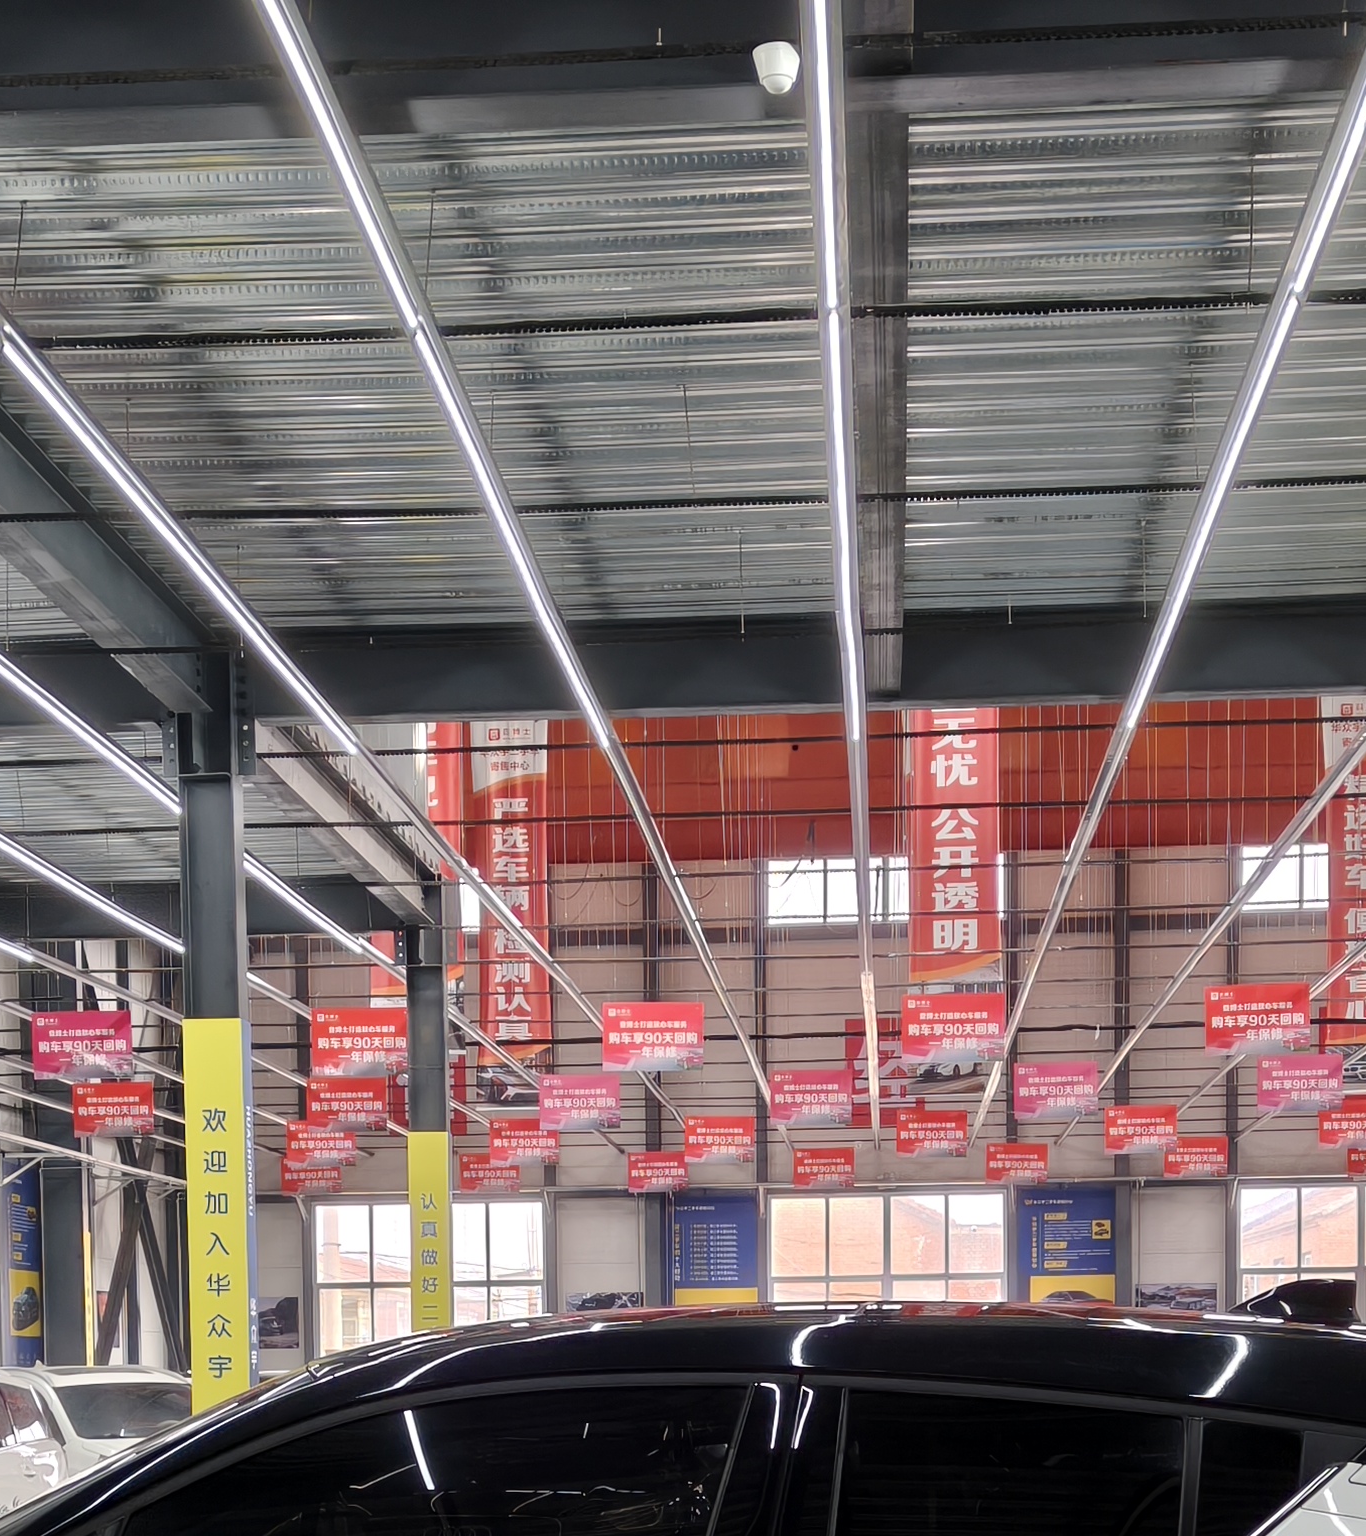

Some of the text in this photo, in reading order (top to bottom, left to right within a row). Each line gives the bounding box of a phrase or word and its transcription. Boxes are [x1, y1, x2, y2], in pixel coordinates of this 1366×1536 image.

[931, 708, 979, 951] 无忧 公开透明
[1211, 1013, 1305, 1028] 购车享90天回购
[908, 1023, 1000, 1036] 购车享90天回购
[318, 1036, 407, 1050] 购车享90天回购
[608, 1031, 698, 1045] 购车享90天回购
[1018, 1084, 1094, 1097] 购车享90天回购
[1262, 1078, 1339, 1090] 购车享90天回购
[544, 1097, 616, 1109] 购车享90天回购
[774, 1092, 848, 1104] 购车享90天回购
[201, 1107, 233, 1379] 欢迎加入华众宇
[420, 1192, 439, 1320] 认真做好二
